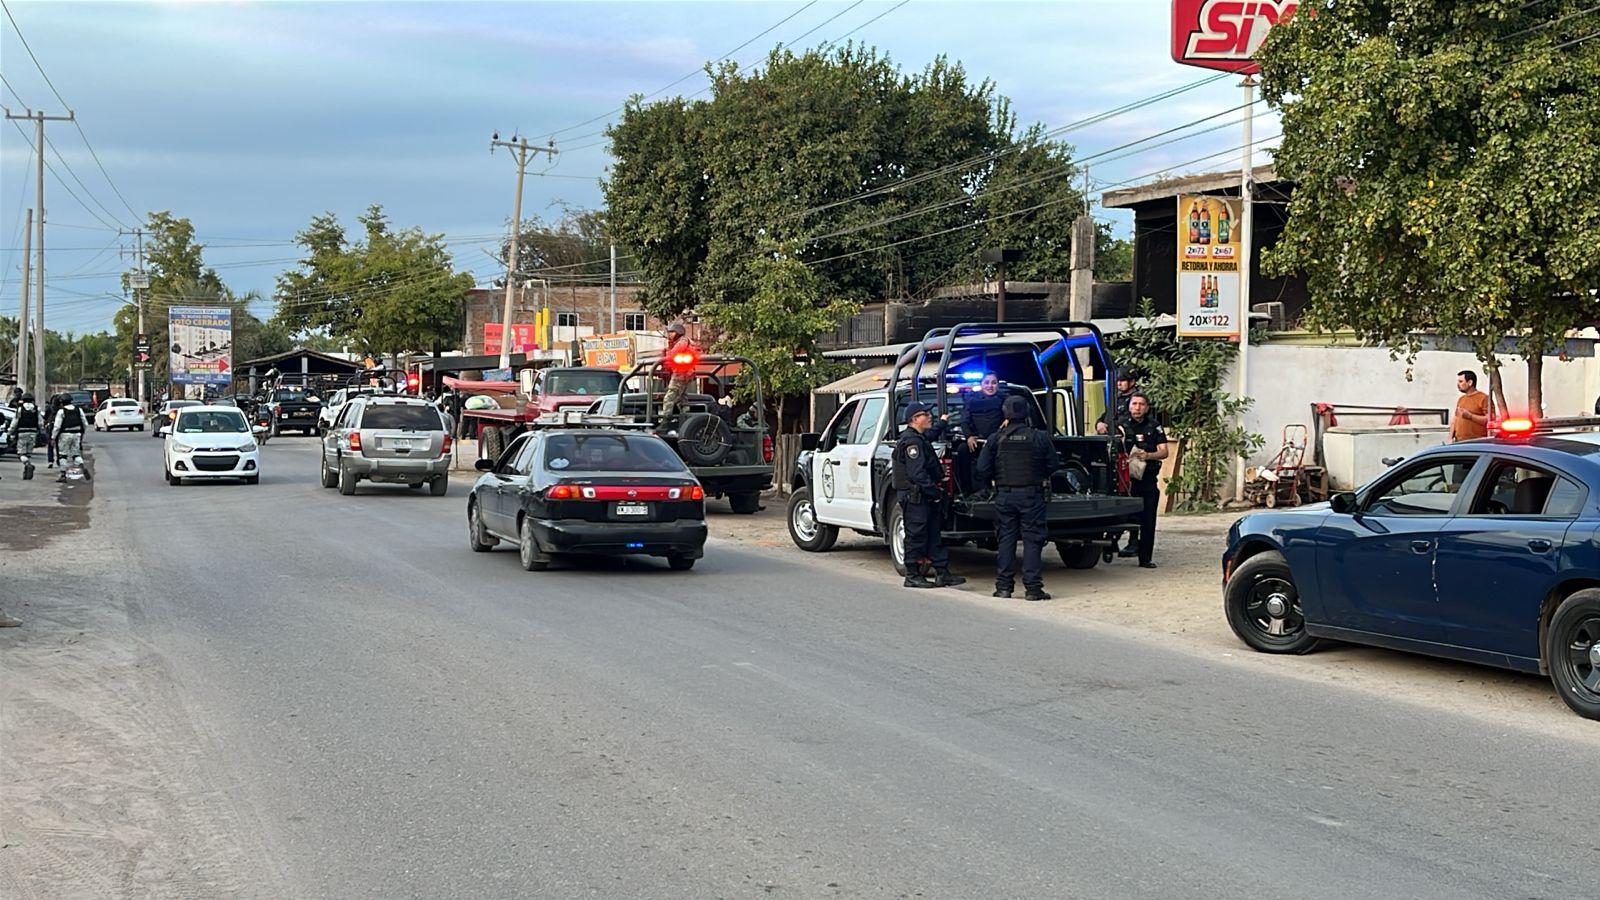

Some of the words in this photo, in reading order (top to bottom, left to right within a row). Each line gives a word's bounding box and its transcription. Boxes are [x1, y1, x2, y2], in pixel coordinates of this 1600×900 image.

[1182, 261, 1208, 270] RETORNA
[1208, 262, 1213, 271] Y
[1214, 262, 1237, 271] AHORRA
